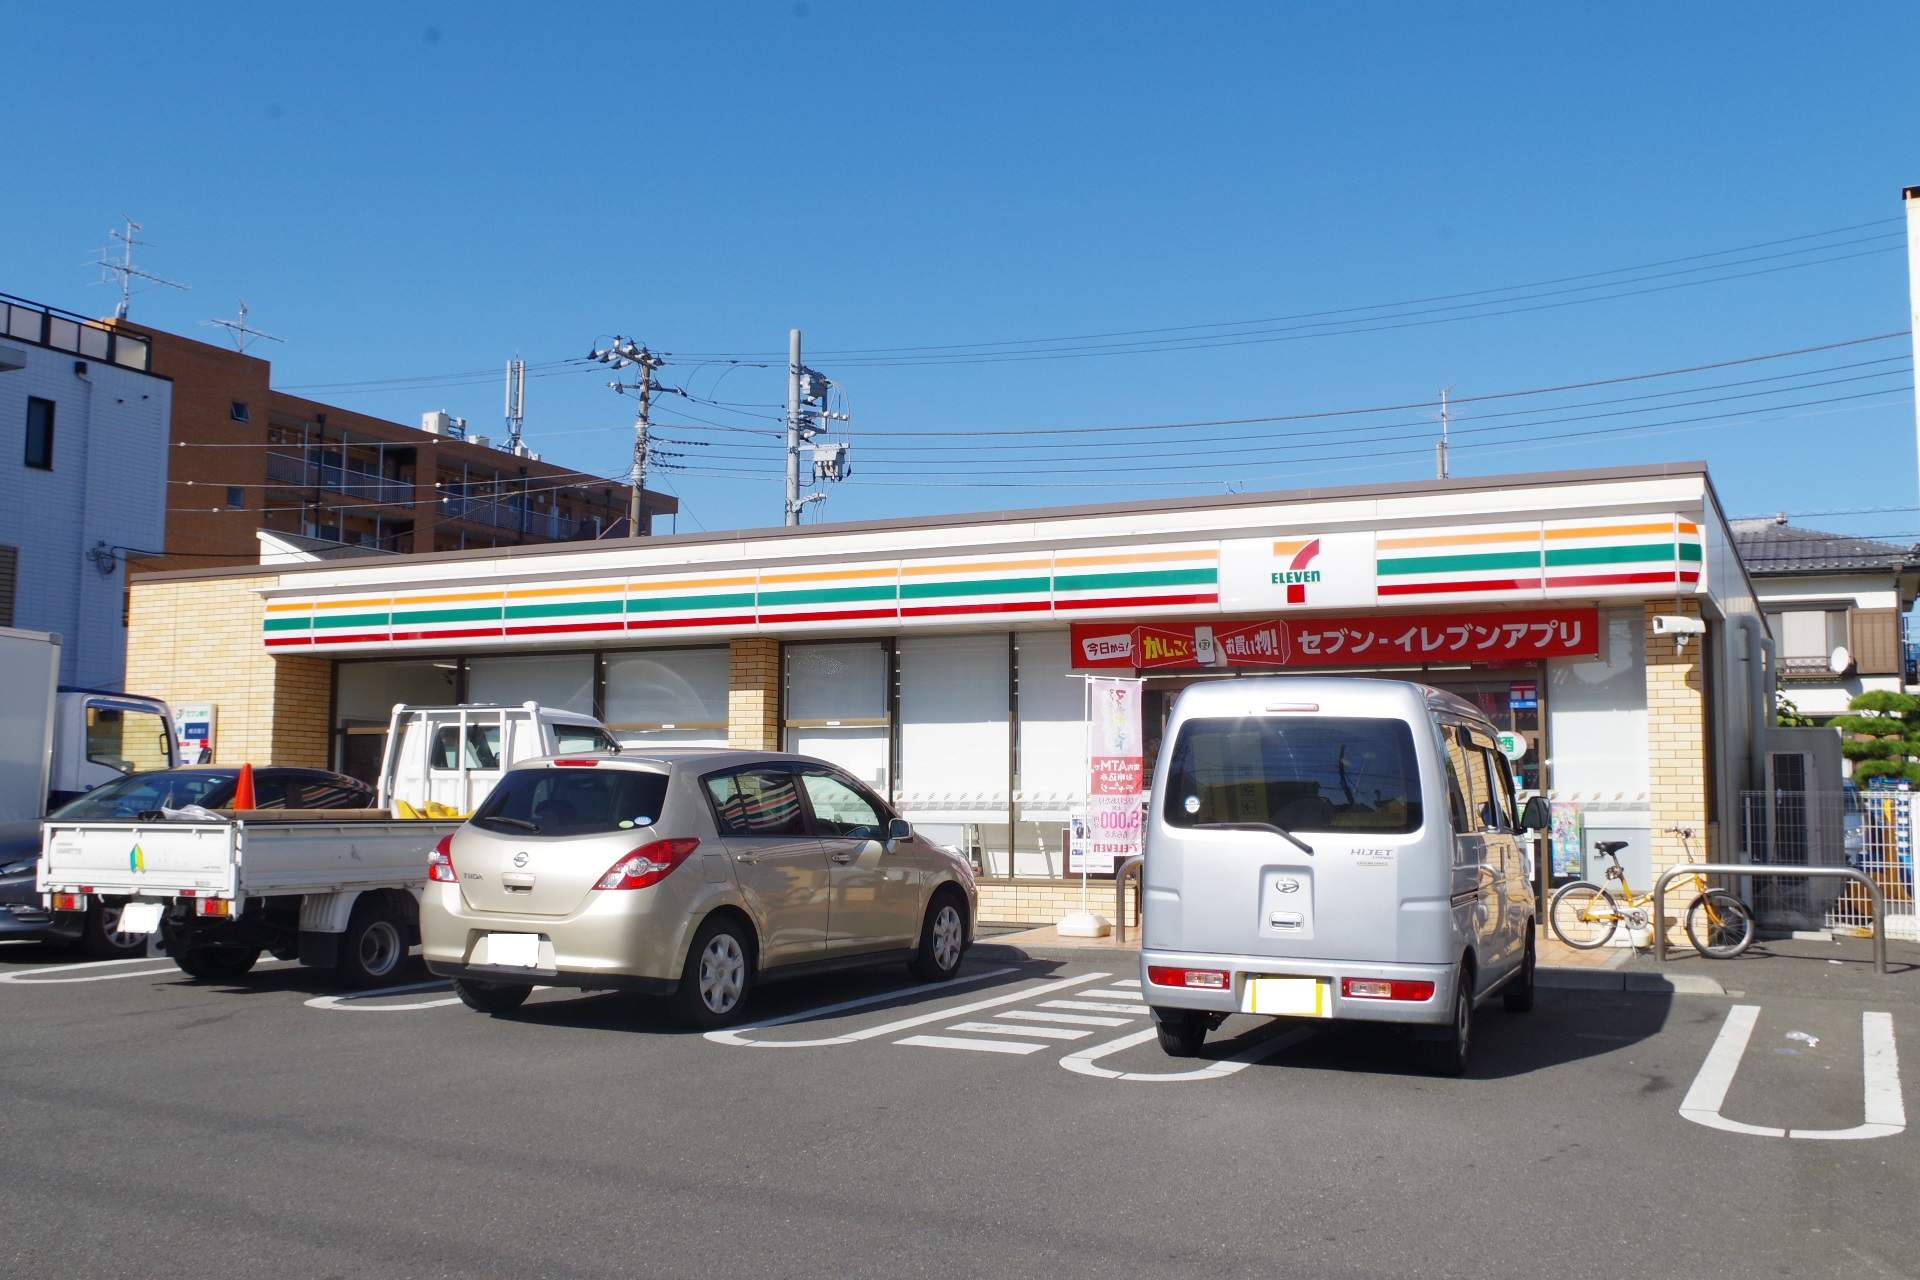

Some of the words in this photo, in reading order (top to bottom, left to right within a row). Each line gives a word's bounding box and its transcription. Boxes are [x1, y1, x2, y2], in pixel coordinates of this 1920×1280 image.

[1086, 640, 1131, 656] 今日から!
[1143, 635, 1189, 661] かしこく
[1225, 628, 1280, 656] お買い物!
[1350, 848, 1393, 856] HIJET
